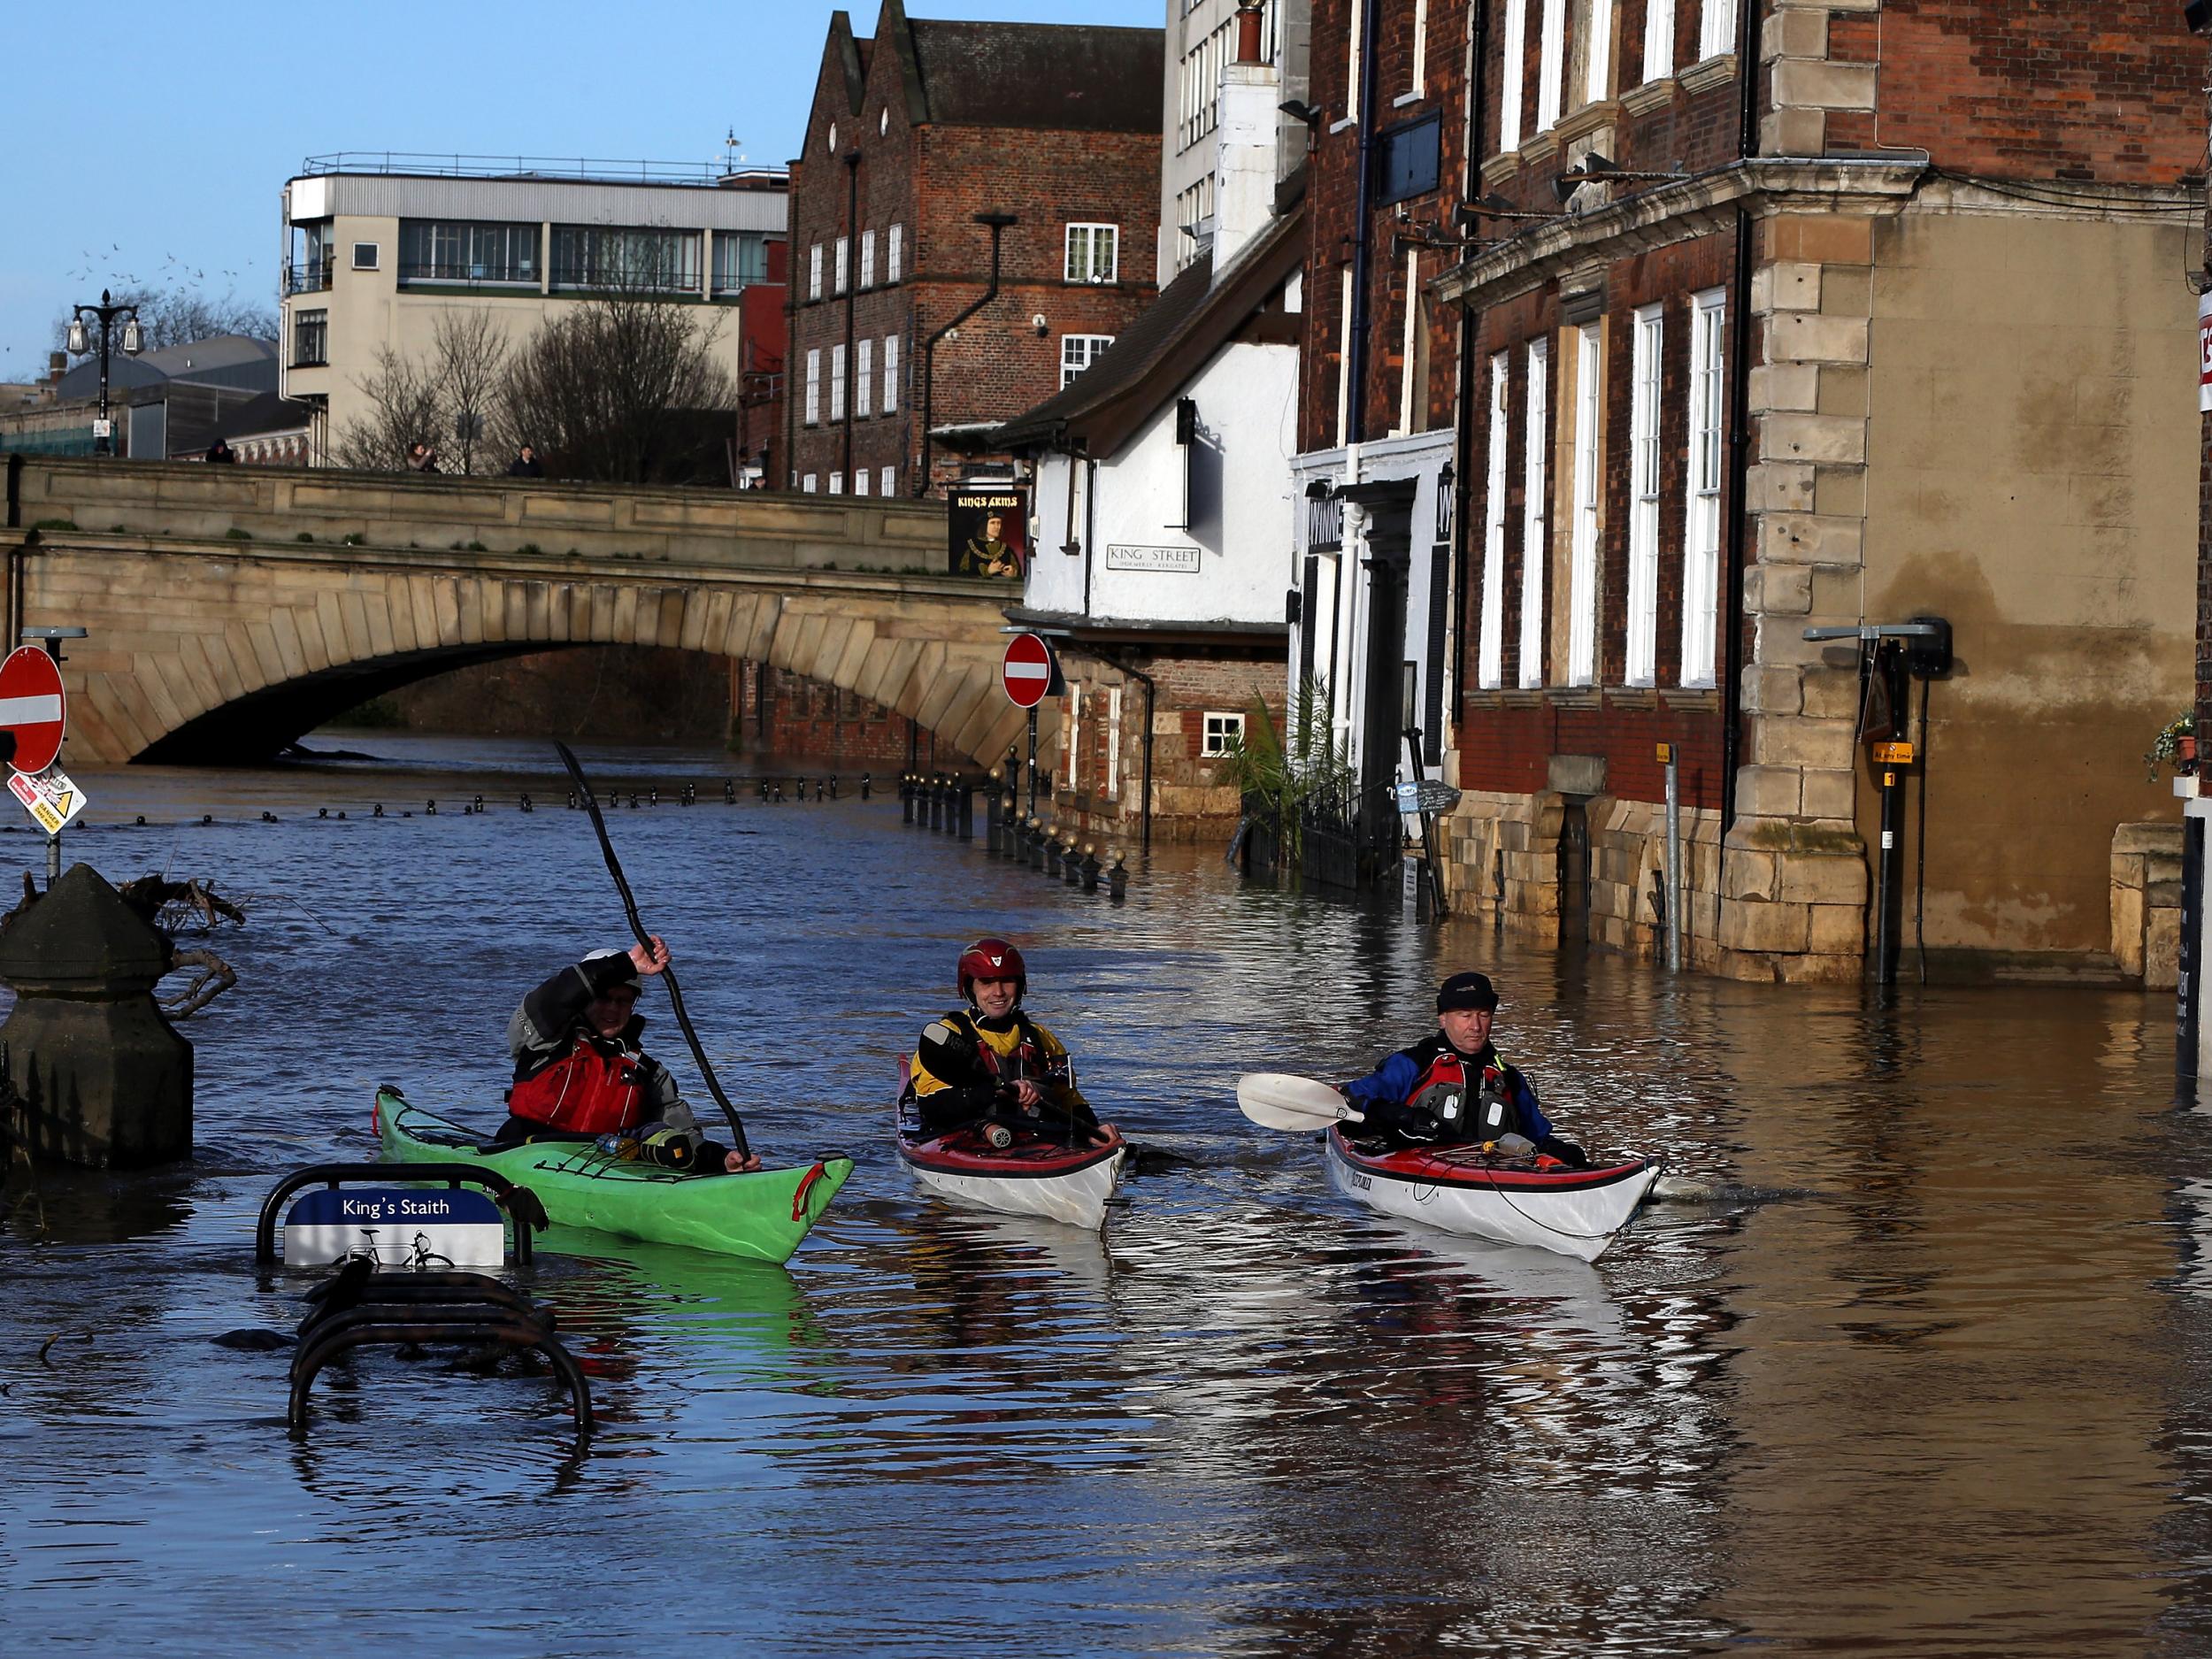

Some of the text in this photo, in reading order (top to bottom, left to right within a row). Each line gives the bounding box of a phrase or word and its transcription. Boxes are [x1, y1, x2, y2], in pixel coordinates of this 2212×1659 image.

[957, 496, 1018, 508] KINGS ARMS
[1110, 548, 1198, 562] KING STREET
[35, 807, 45, 819] Deep
[39, 803, 59, 825] DANGER
[342, 1197, 449, 1218] King's Staith
